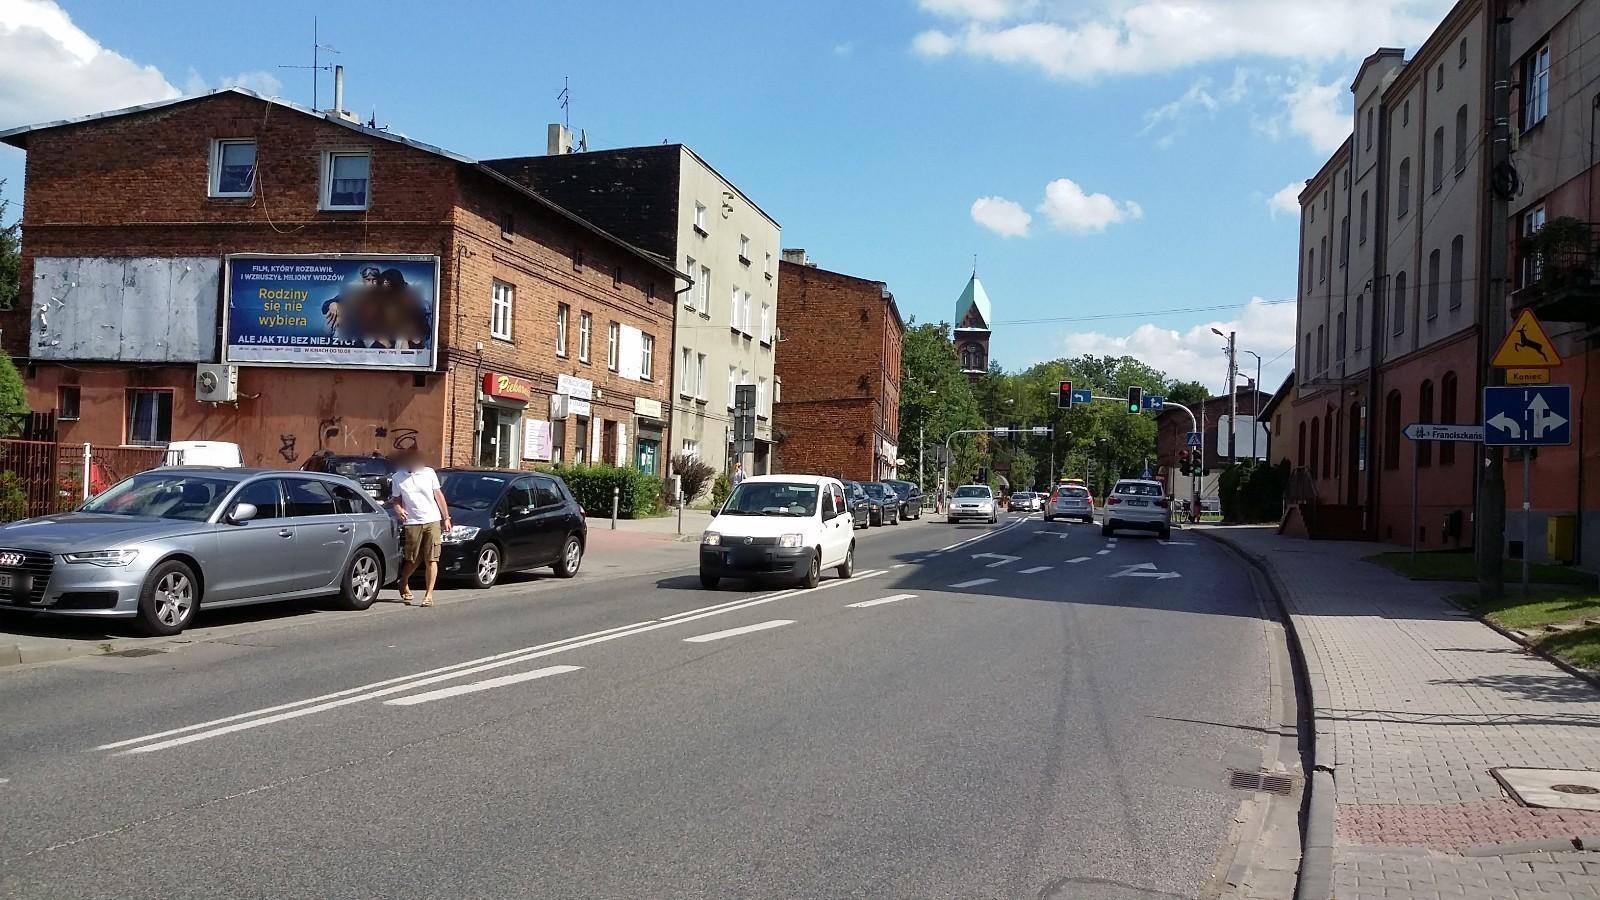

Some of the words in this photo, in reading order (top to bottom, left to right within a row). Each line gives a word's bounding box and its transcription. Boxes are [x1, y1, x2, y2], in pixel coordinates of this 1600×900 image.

[252, 265, 270, 273] FILM,
[271, 264, 294, 272] KTÓRY
[313, 273, 345, 281] WIDZÓW
[258, 288, 308, 301] Rodziny
[263, 300, 280, 312] się
[285, 300, 302, 311] nie
[258, 314, 307, 327] wybiera
[238, 335, 256, 343] ALE
[290, 336, 308, 344] BEZ
[310, 336, 330, 345] NIEJ
